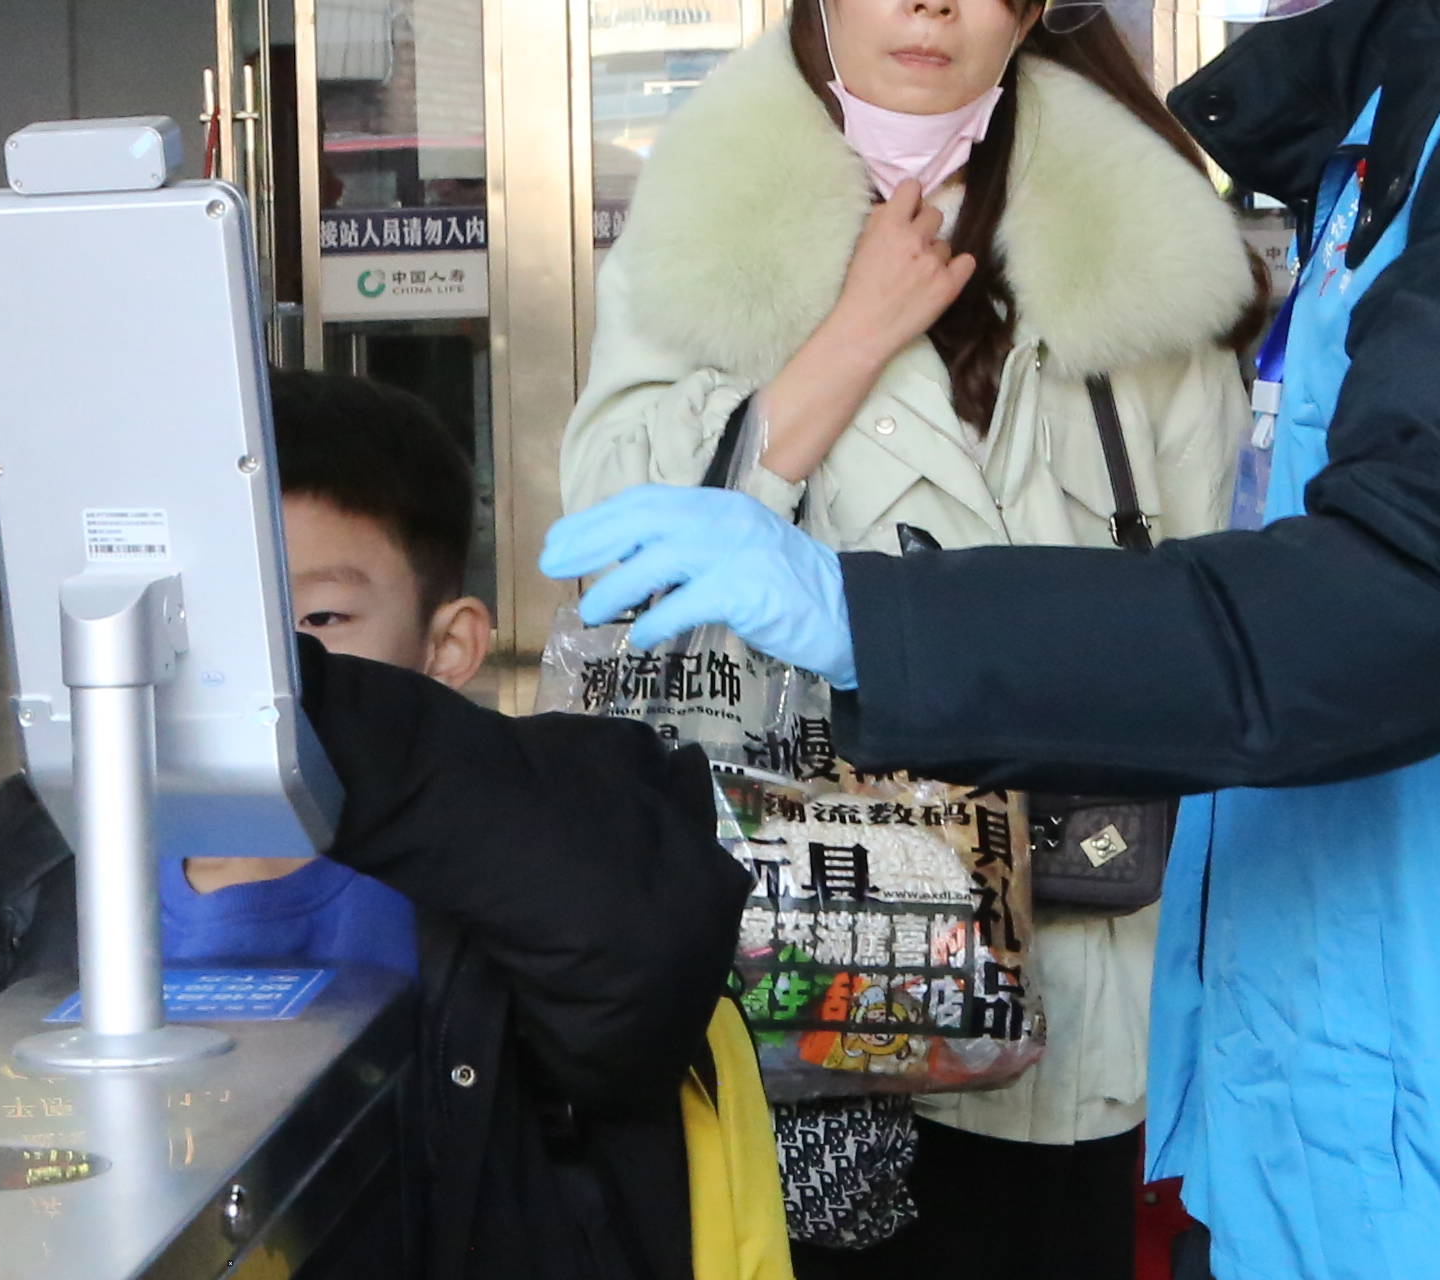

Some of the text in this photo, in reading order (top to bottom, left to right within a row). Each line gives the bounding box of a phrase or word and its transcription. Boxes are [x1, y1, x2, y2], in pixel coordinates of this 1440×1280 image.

[320, 216, 487, 249] 接站人员请勿入内
[391, 268, 466, 285] 中国人寿
[391, 285, 466, 296] CHINA LIFE
[580, 649, 742, 711] 潮流配饰
[764, 790, 971, 827] 潮流数码
